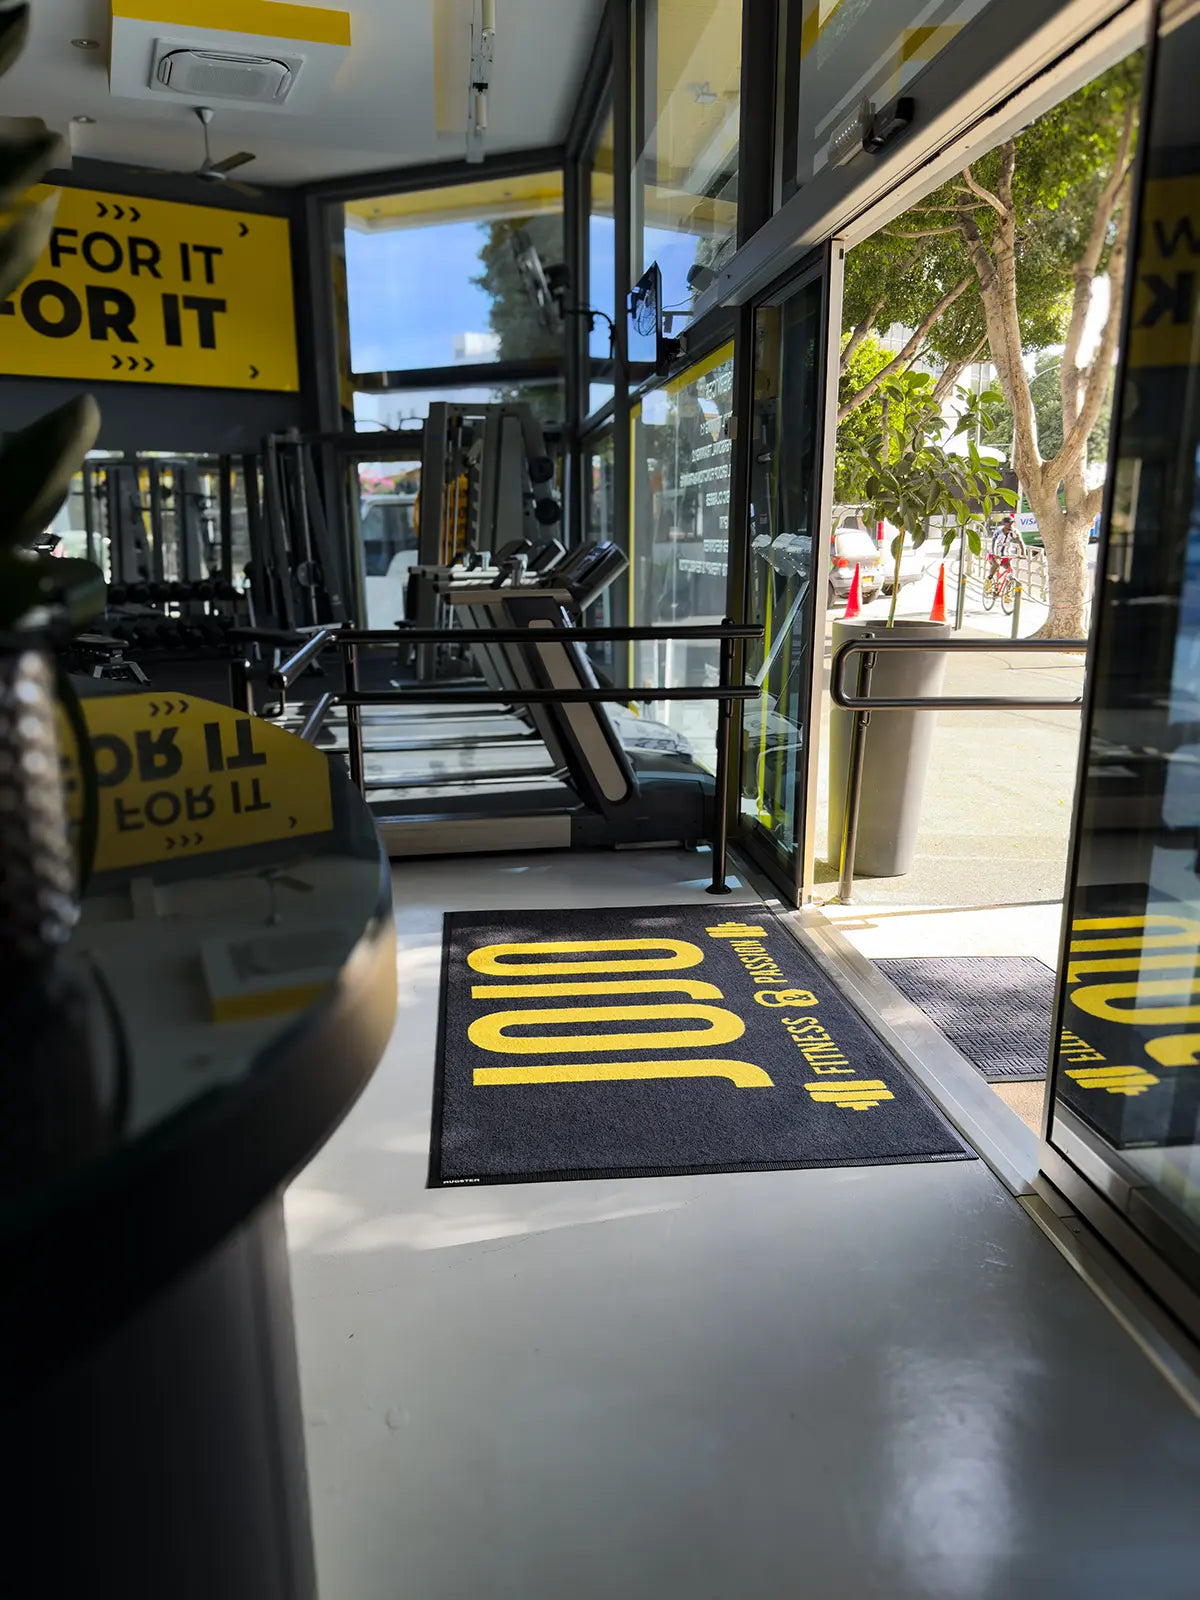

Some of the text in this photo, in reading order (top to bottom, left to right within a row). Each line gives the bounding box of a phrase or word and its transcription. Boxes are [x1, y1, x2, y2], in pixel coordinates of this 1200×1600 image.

[50, 227, 223, 284] FOR IT
[0, 279, 227, 349] OR IT
[729, 940, 789, 985] PASSION
[467, 938, 776, 1088] JOJO
[781, 1016, 856, 1075] FITNESS
